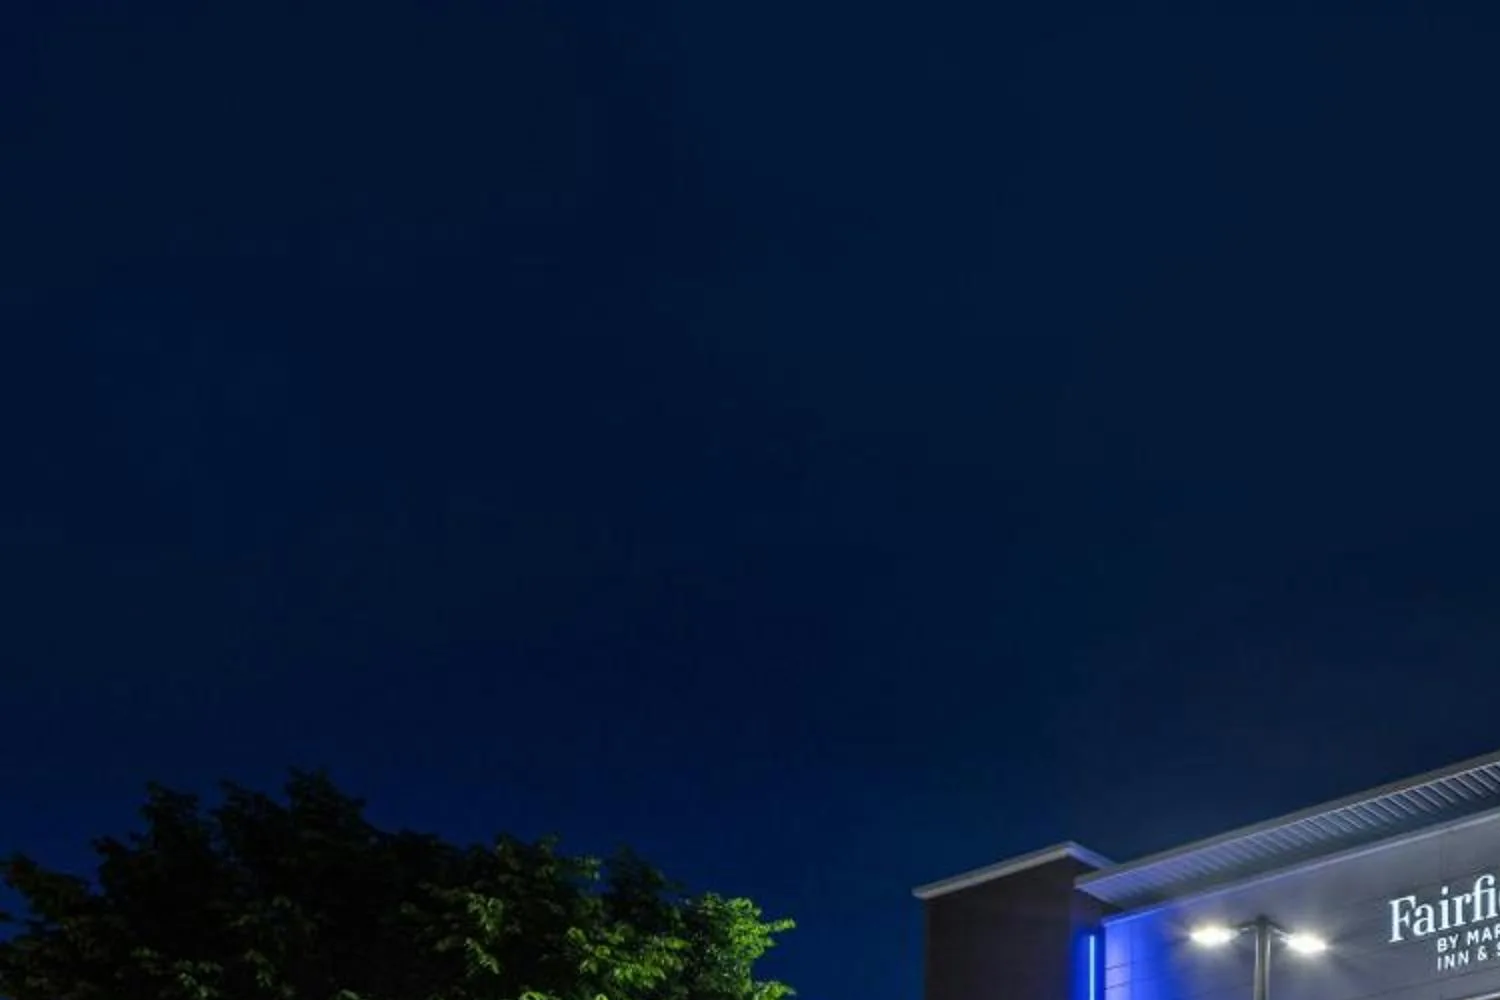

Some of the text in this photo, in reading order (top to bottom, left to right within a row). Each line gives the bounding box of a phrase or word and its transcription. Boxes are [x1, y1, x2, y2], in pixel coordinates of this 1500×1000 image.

[1436, 934, 1459, 952] BY
[1436, 951, 1470, 971] INN
[1477, 946, 1488, 961] &
